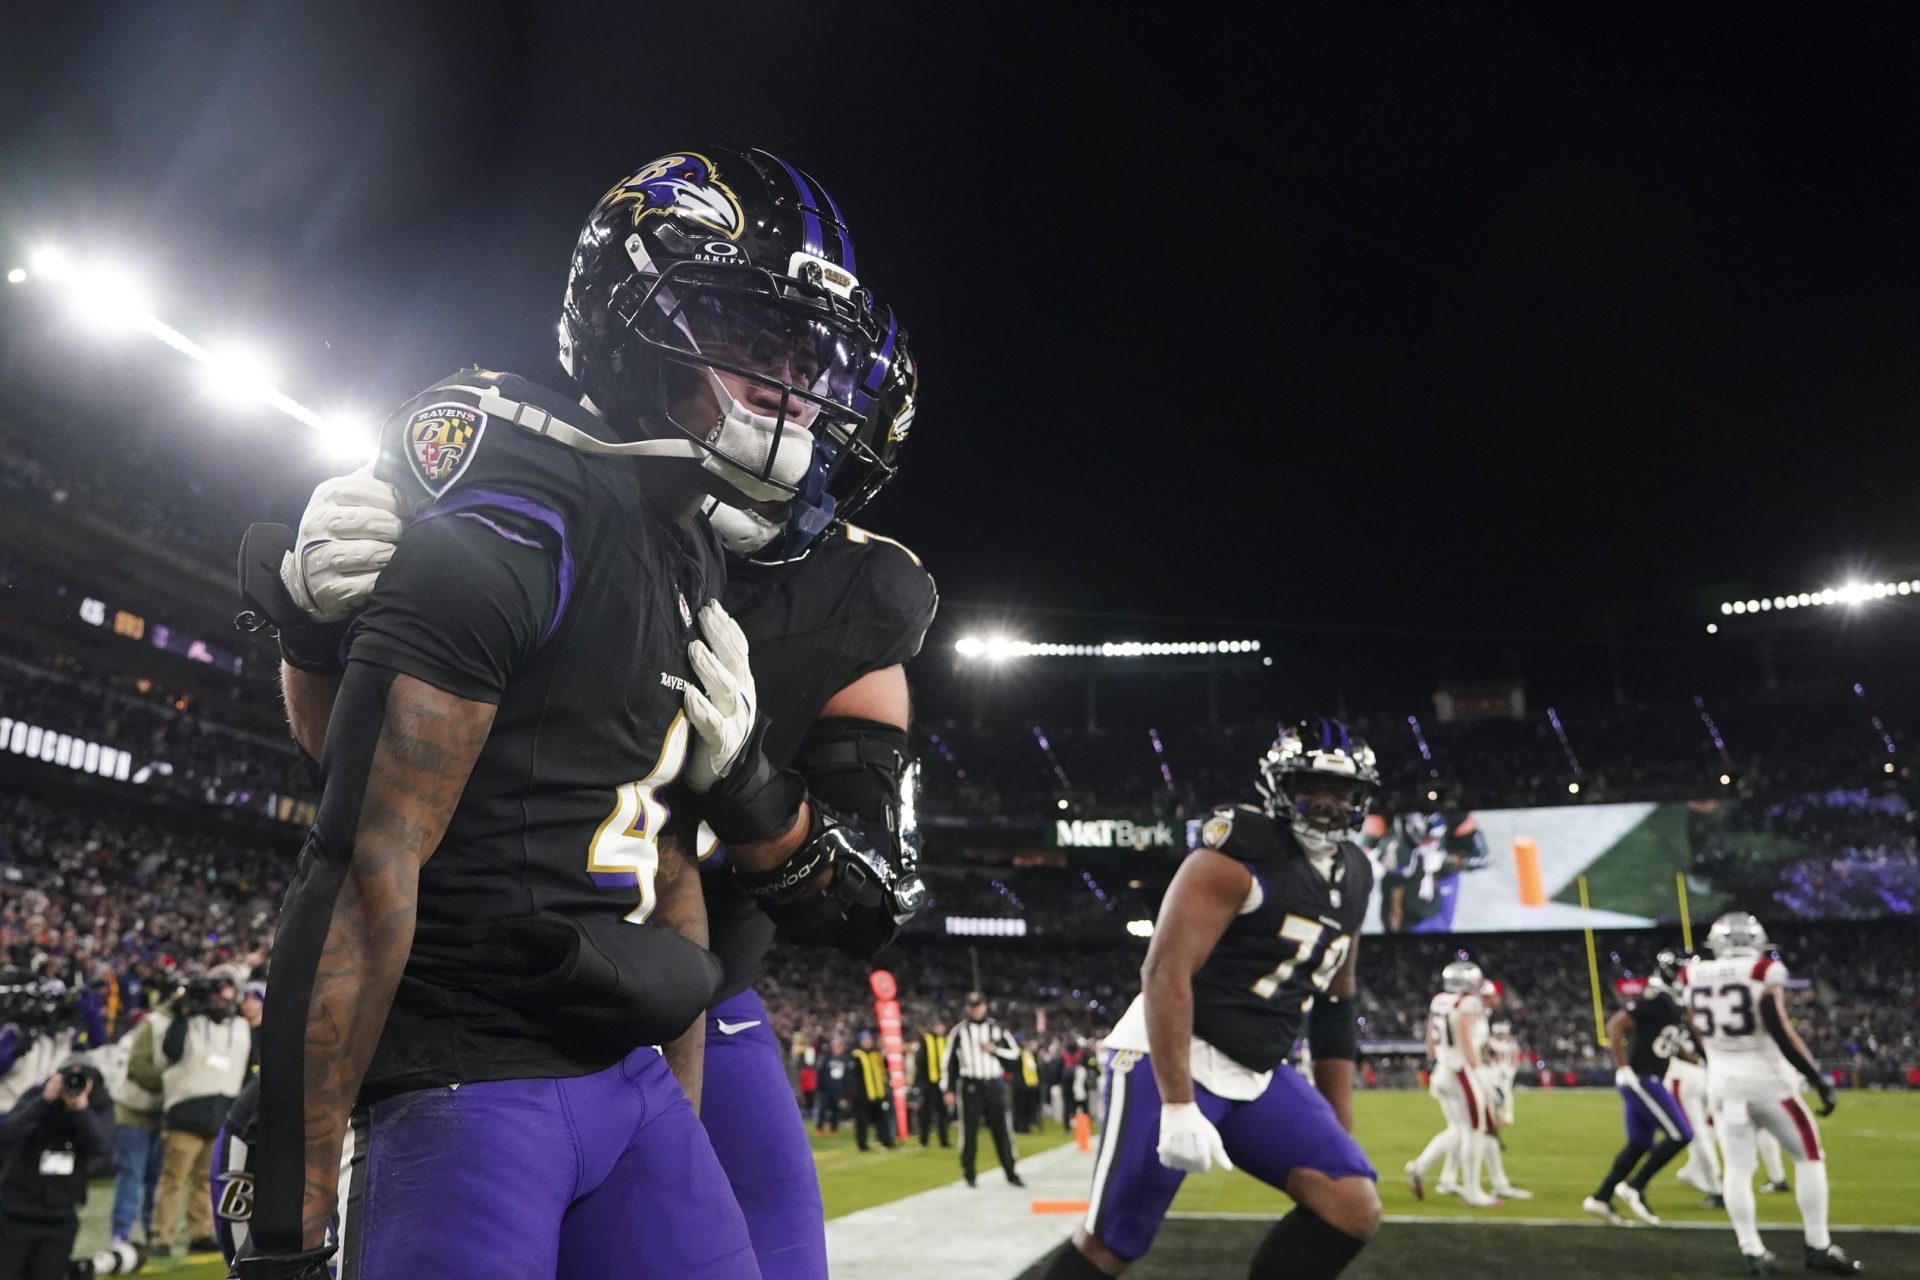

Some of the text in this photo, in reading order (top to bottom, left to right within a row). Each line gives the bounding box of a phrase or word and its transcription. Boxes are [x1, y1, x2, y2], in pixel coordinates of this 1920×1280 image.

[623, 156, 686, 187] B
[694, 253, 745, 265] OAKLEY
[417, 408, 476, 422] RAVENS
[660, 672, 693, 692] RAVEN
[586, 707, 690, 925] 4
[1115, 819, 1174, 847] Bank
[1692, 982, 1756, 1037] 53
[216, 1170, 255, 1221] B
